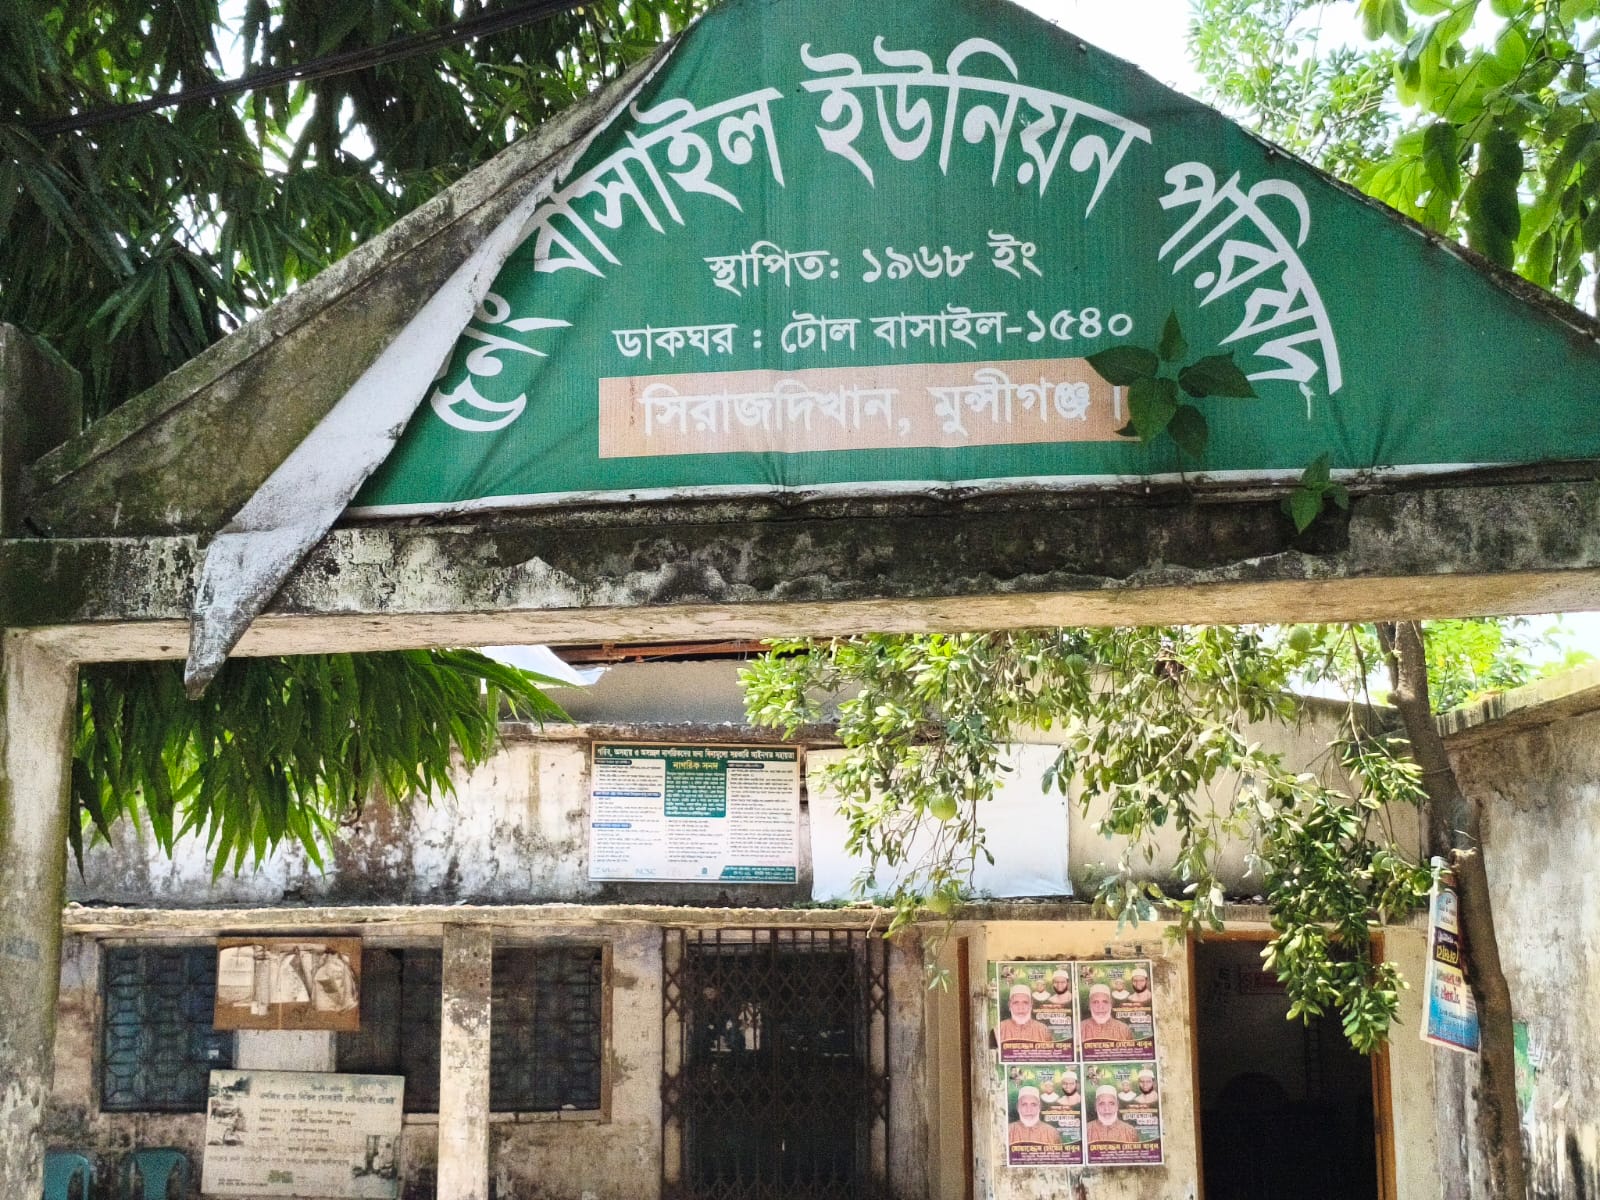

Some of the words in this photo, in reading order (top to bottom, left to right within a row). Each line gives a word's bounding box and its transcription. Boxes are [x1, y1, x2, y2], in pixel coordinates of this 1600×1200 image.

[516, 86, 786, 279] বাসাইল
[799, 34, 1153, 219] ইউনিয়ন
[1156, 160, 1344, 422] পরিষদ
[703, 240, 840, 297] স্থাপিত:
[861, 245, 975, 284] ১৯৬৮
[986, 229, 1044, 279] ইং
[612, 323, 738, 361] ডাকঘর
[752, 328, 763, 349] :
[780, 310, 860, 355] টোল
[868, 303, 1134, 351] বাসাইল-১৫৪০
[638, 378, 912, 437] সিরাজদিখান,
[927, 366, 1092, 437] মুন্সীগঞ্জ
